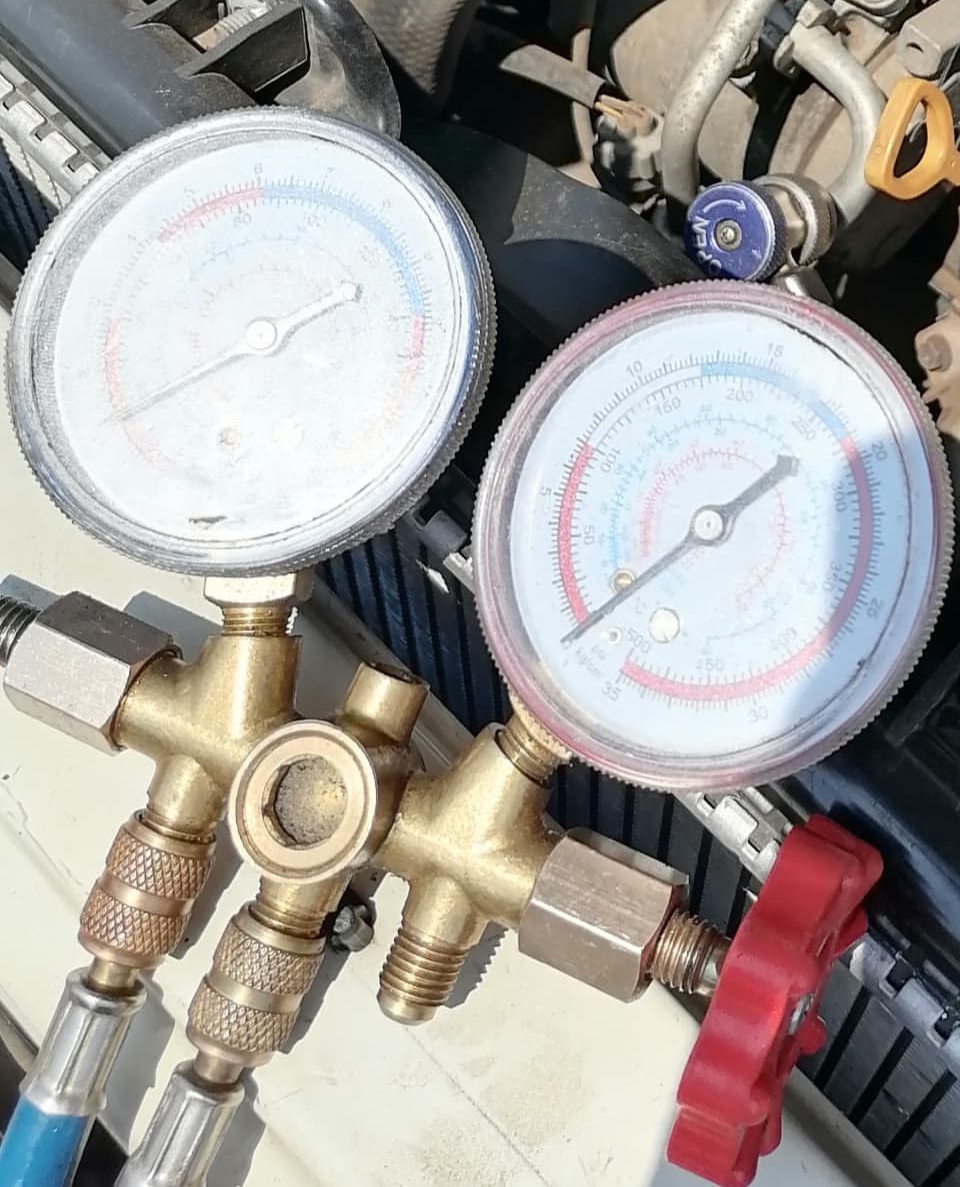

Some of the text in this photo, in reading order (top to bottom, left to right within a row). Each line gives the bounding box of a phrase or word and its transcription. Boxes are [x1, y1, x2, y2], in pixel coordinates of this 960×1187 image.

[253, 162, 264, 175] 6
[232, 213, 253, 229] 80
[767, 342, 785, 358] 15
[625, 359, 644, 378] 10
[725, 387, 754, 403] 200
[655, 396, 683, 417] 150
[792, 416, 817, 441] 250
[600, 446, 621, 475] 100
[871, 440, 888, 462] 20
[540, 486, 553, 498] 5
[832, 480, 847, 513] 300
[583, 525, 596, 546] 50
[822, 561, 842, 592] 350
[866, 597, 884, 618] 25
[626, 627, 652, 655] 500
[600, 679, 624, 703] 35
[747, 707, 769, 724] 30
